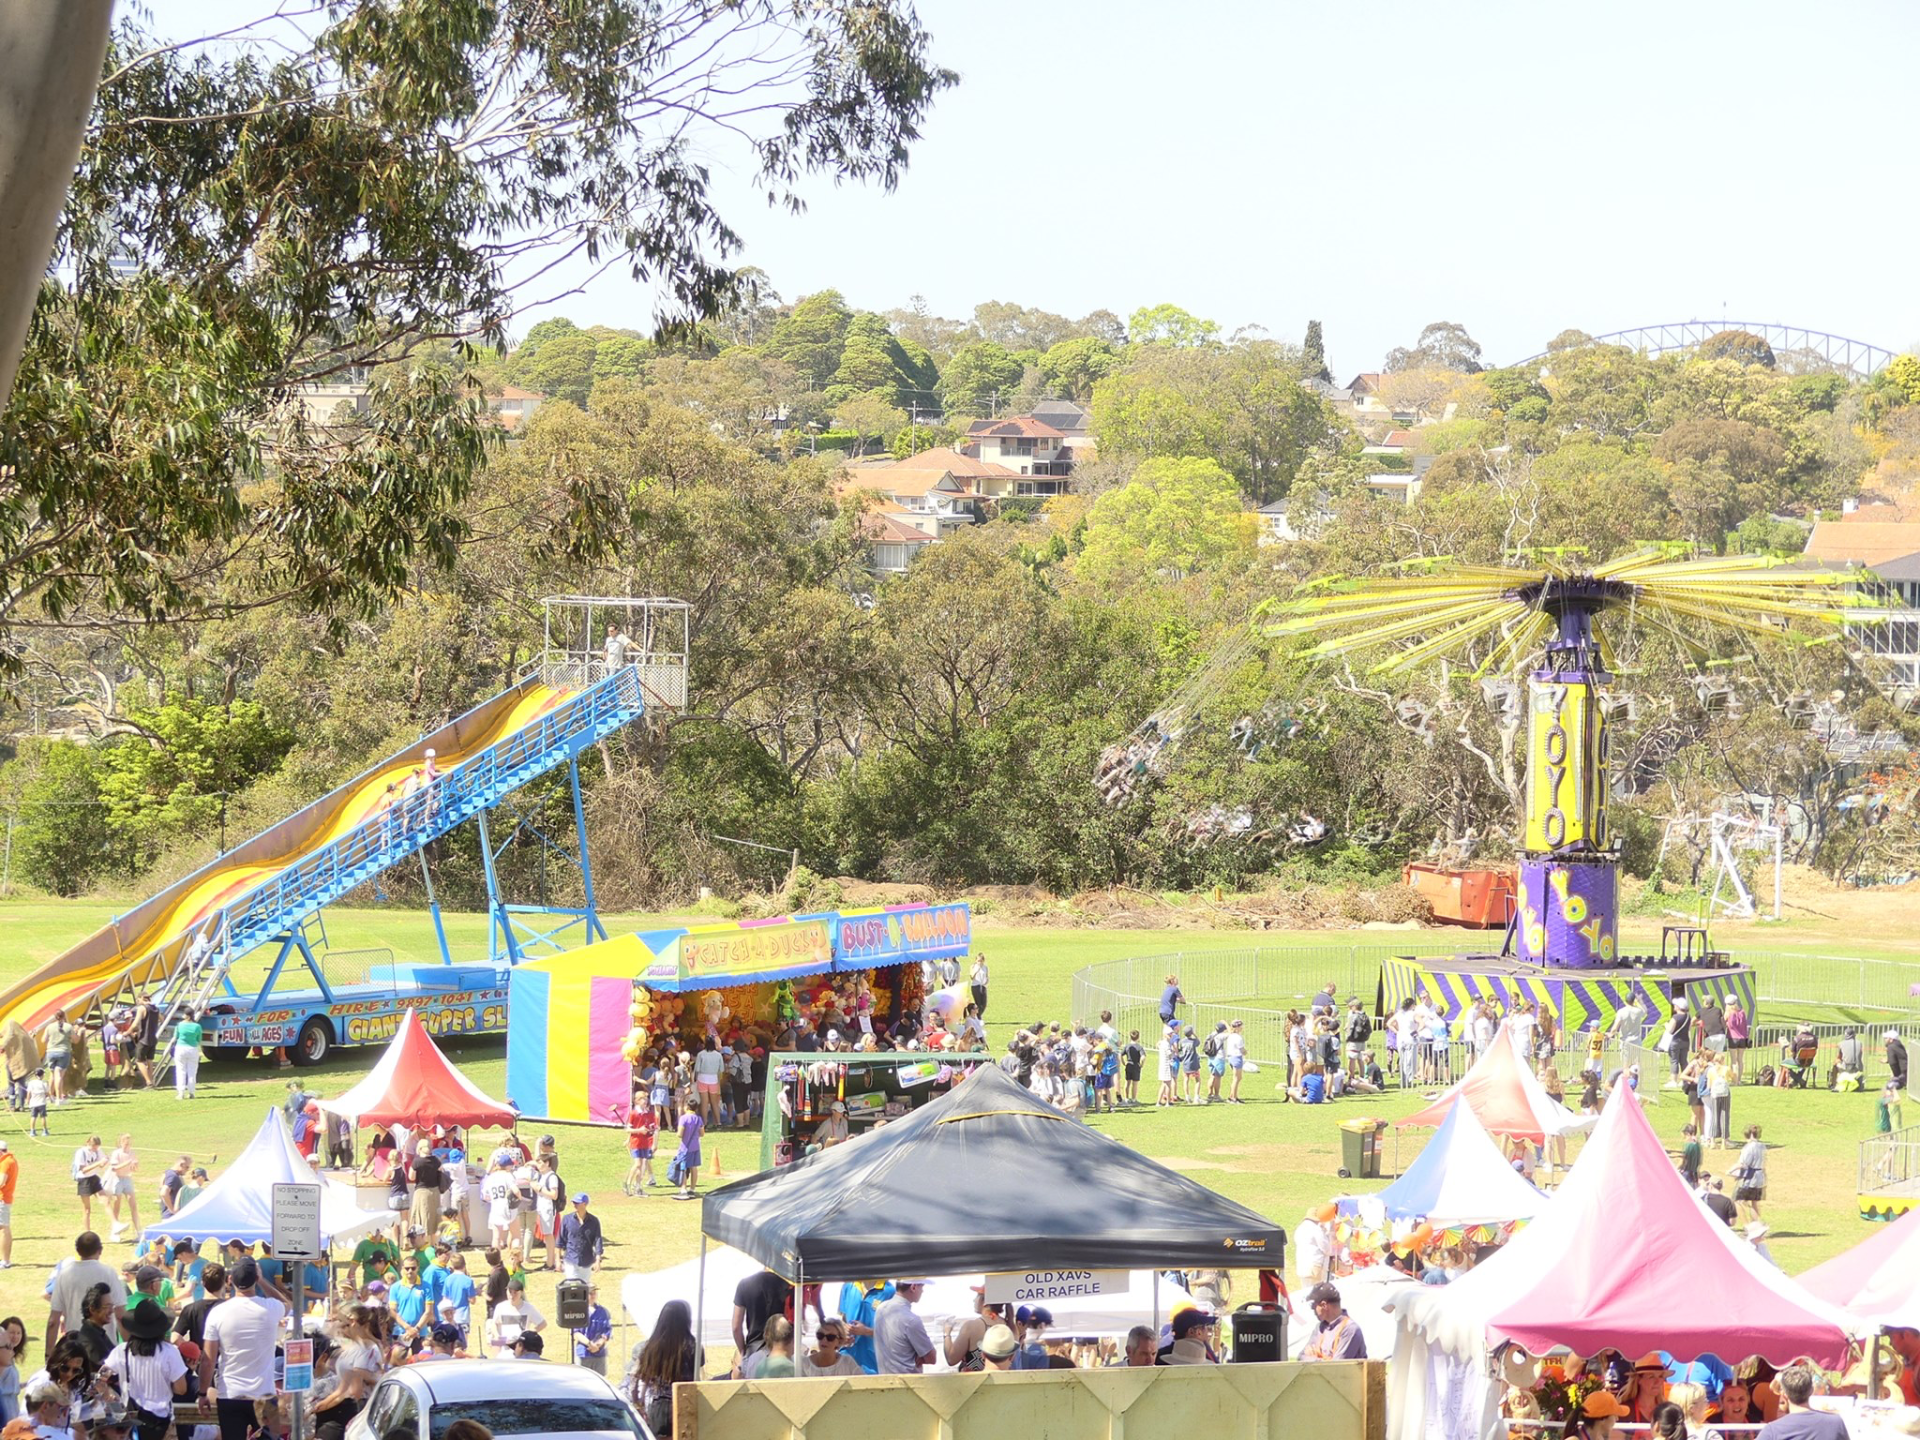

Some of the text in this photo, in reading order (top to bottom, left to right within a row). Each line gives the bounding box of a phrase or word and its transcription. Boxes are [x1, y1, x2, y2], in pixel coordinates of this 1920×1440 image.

[842, 919, 884, 951] BUST
[902, 908, 967, 942] BALLOON
[700, 937, 751, 965] CATCH
[768, 928, 812, 959] DUCK
[256, 1009, 290, 1023] FOR
[397, 995, 433, 1009] 9897
[441, 992, 473, 1005] 1041
[221, 1027, 244, 1043] FUN
[261, 1025, 282, 1042] AGES
[1592, 1040, 1603, 1051] 37
[1025, 1271, 1092, 1284] OLD XAVS
[1015, 1283, 1100, 1300] CAR RAFFLE
[564, 1312, 586, 1320] MIPRO
[1239, 1333, 1275, 1344] MIPRO
